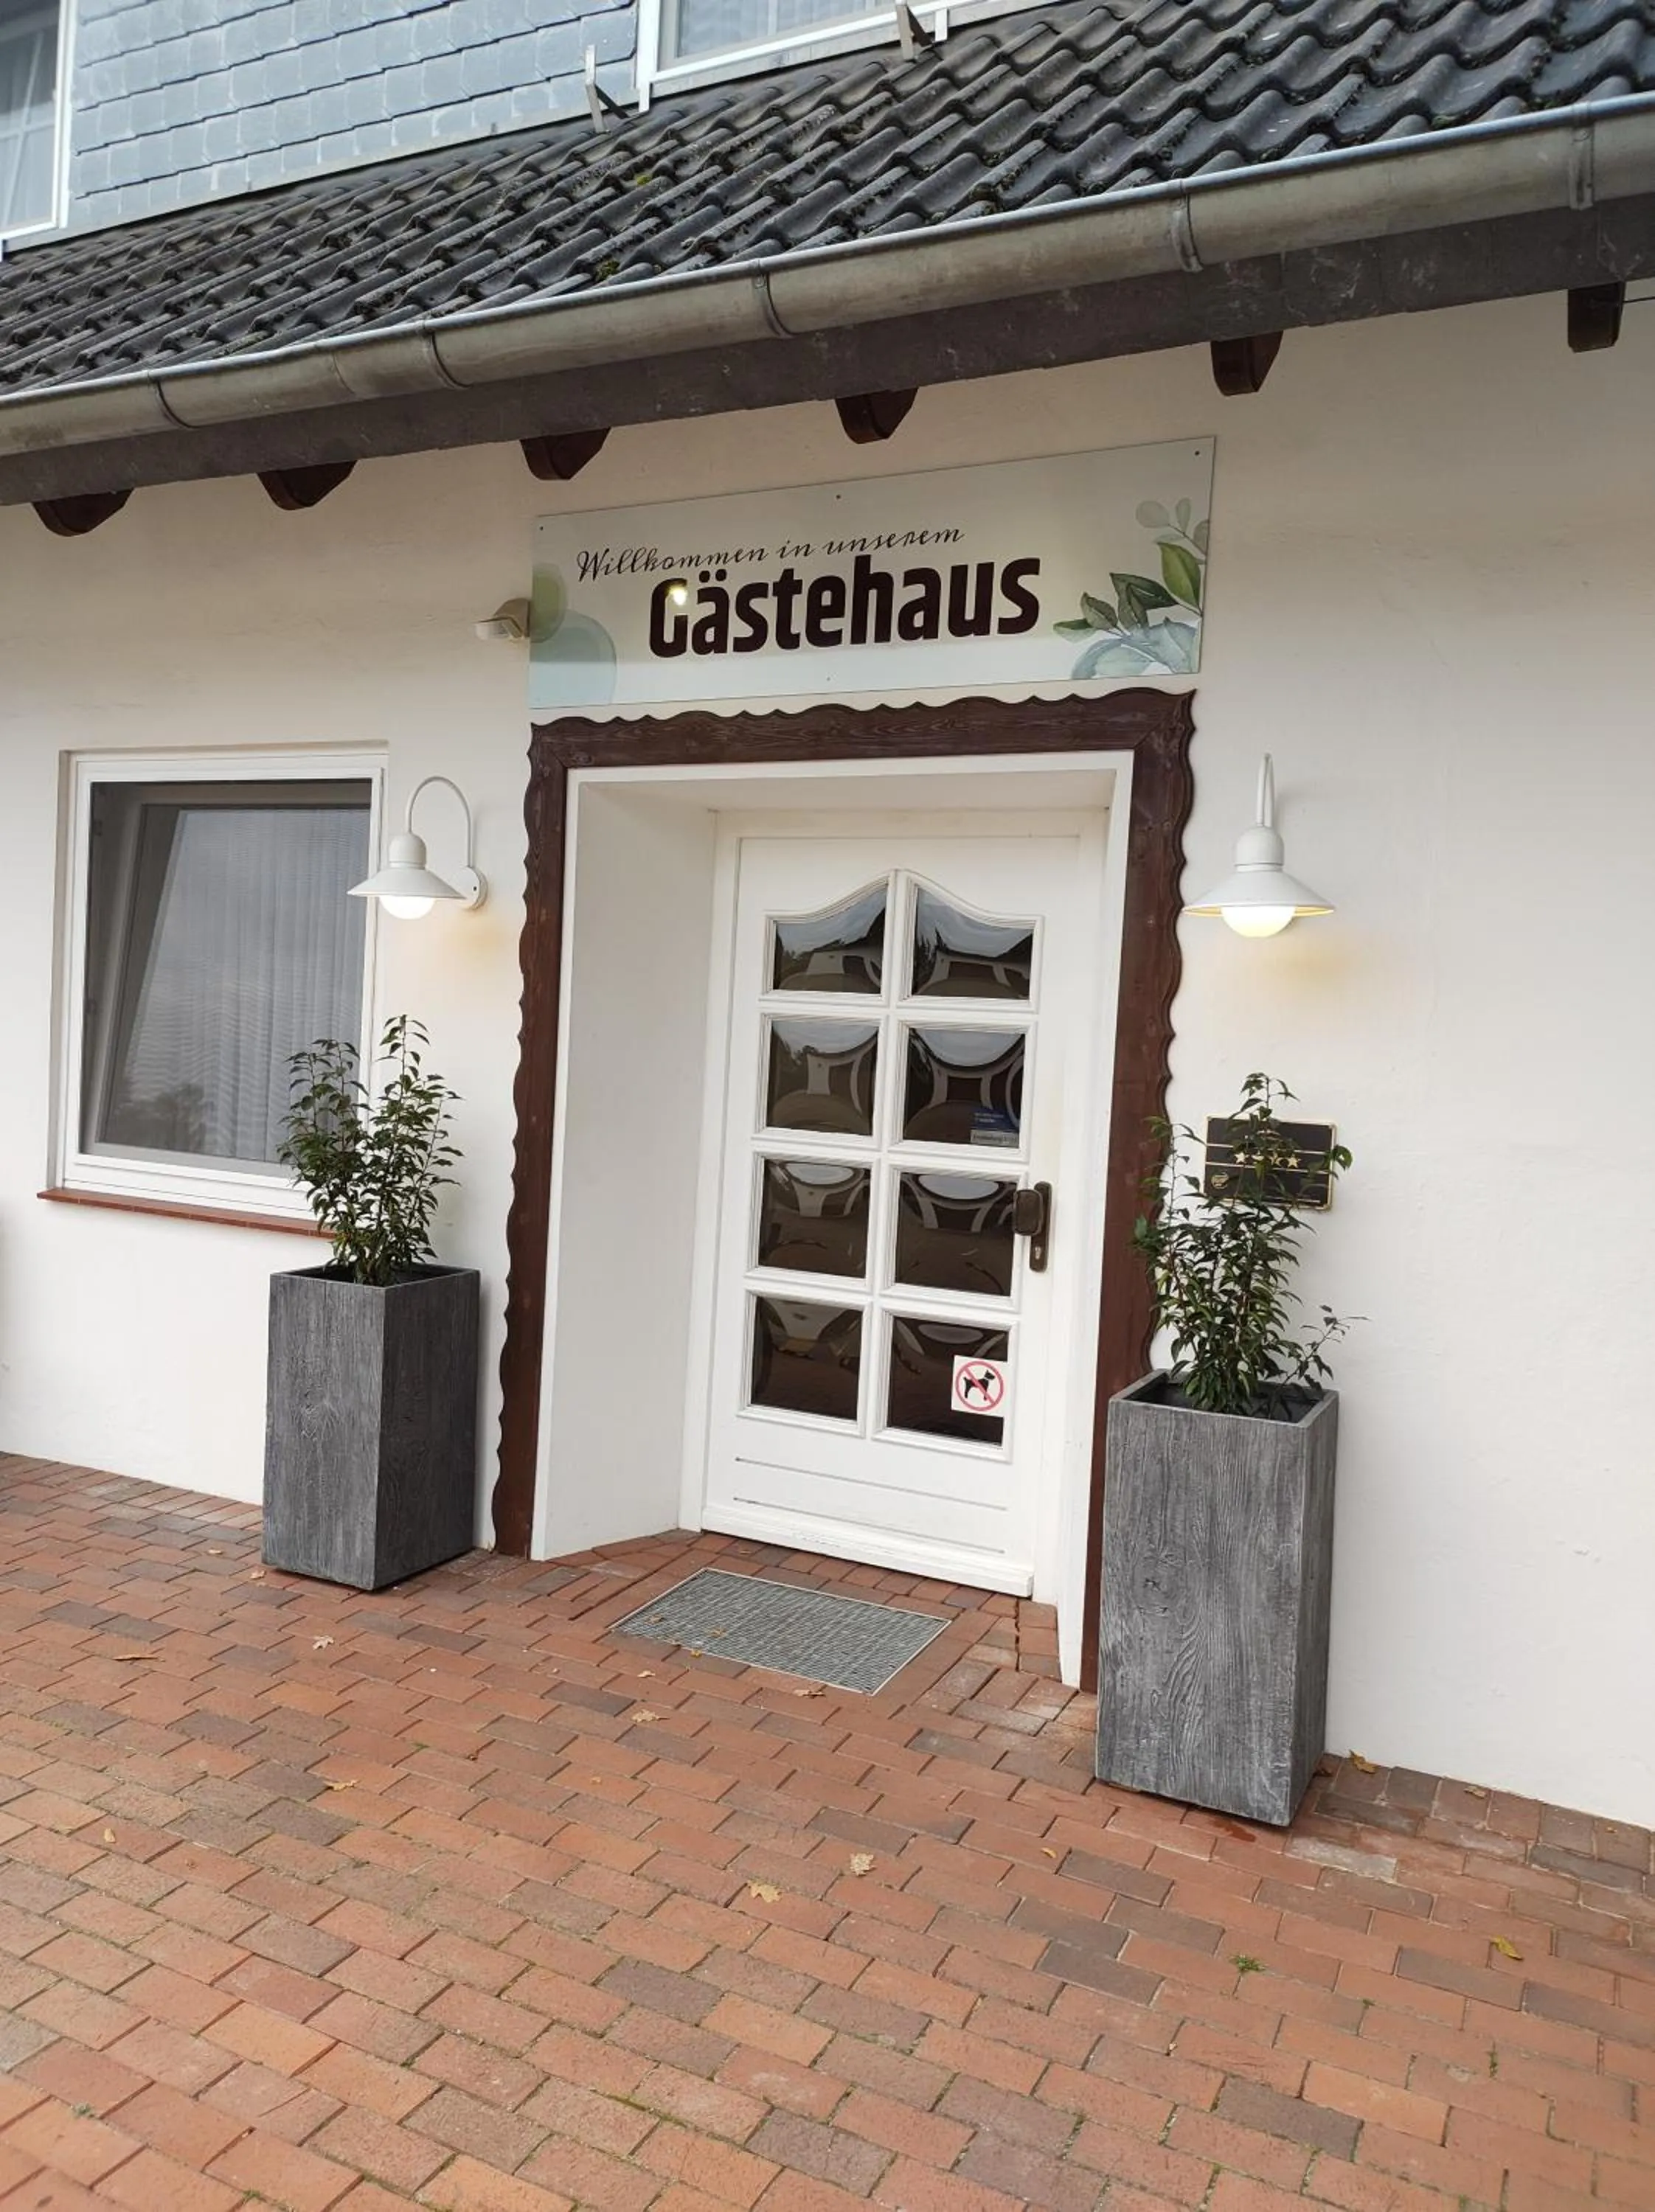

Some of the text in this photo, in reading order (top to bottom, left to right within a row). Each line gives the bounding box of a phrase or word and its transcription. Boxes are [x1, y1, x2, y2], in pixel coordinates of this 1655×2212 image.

[577, 526, 965, 582] Willkommen in unserem
[649, 554, 1041, 658] Gästehaus
